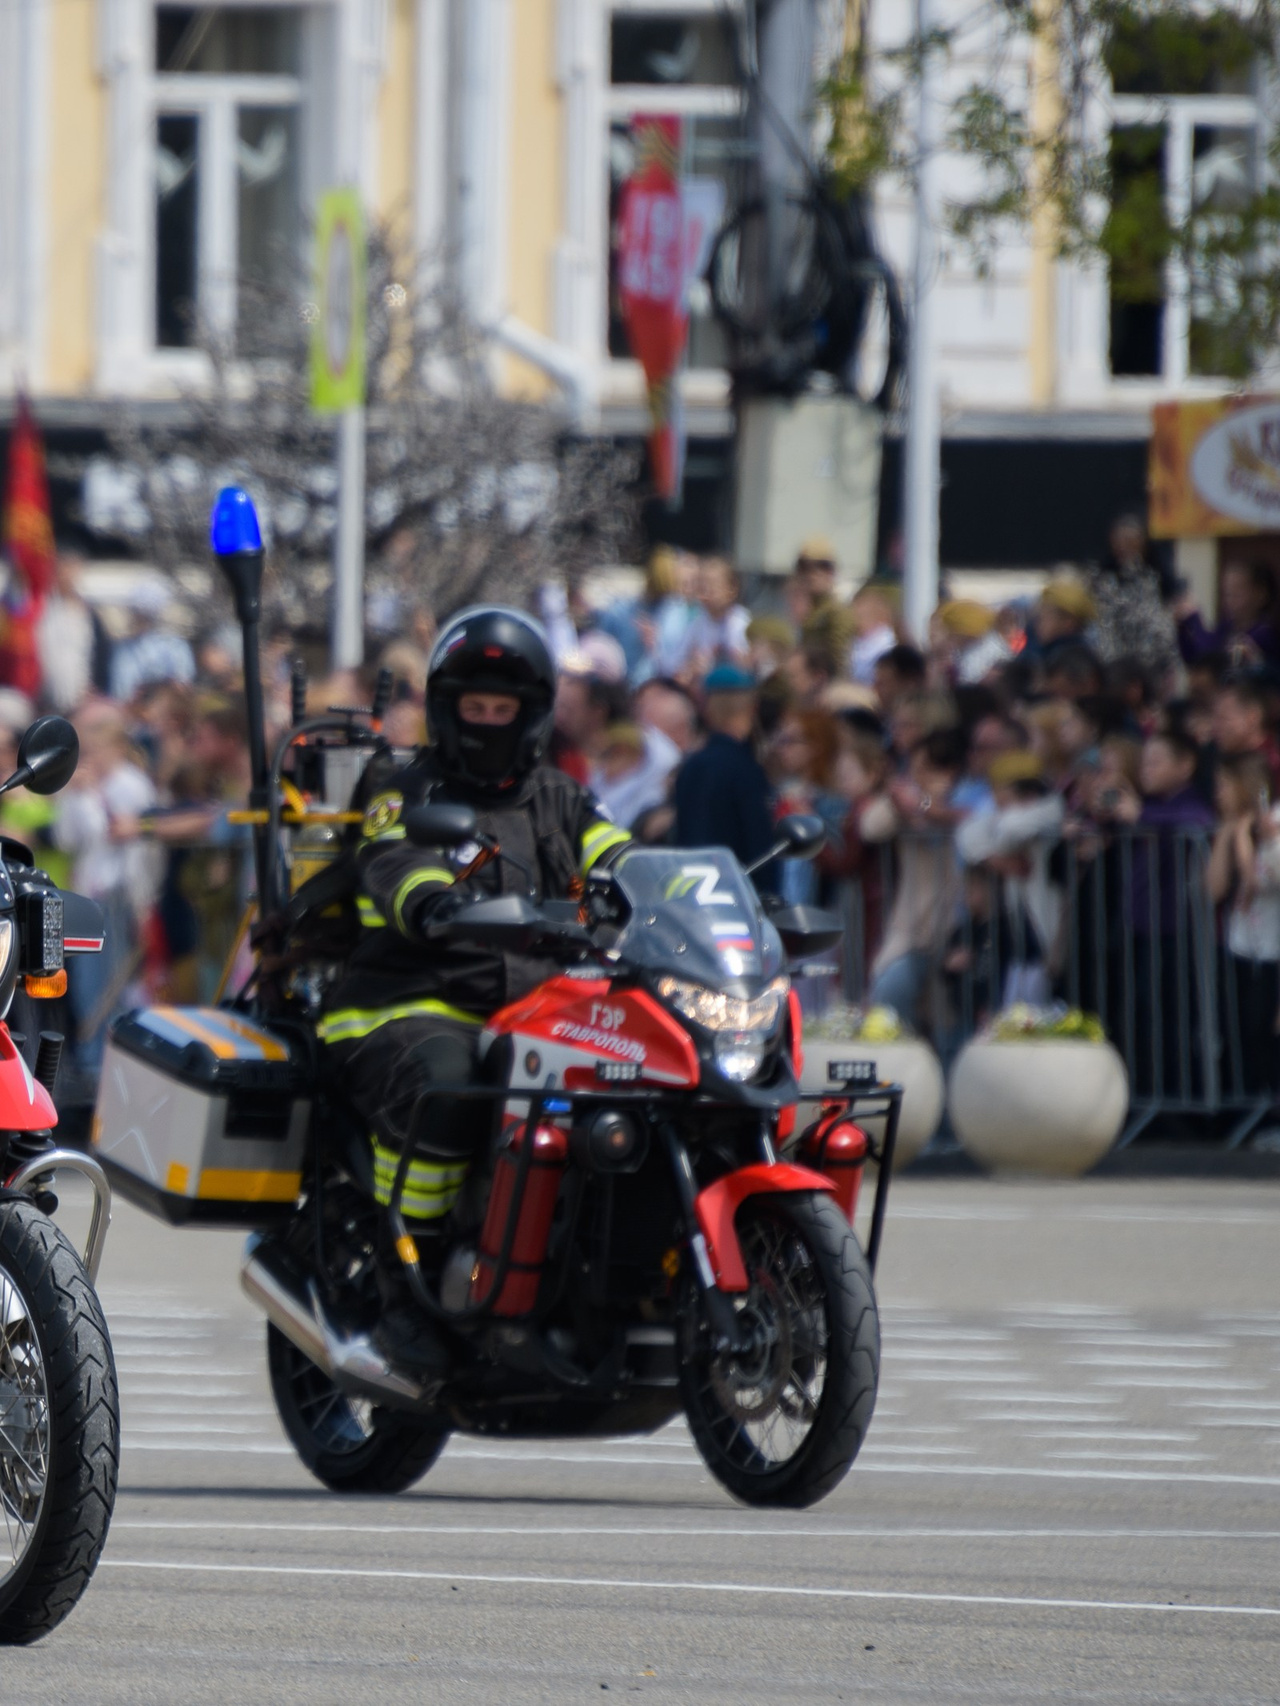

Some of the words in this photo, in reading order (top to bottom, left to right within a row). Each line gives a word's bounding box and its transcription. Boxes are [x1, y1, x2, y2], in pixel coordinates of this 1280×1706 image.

[682, 866, 735, 905] Z
[589, 1002, 626, 1031] ГЭР
[550, 1020, 648, 1063] СТАВРОПОЛЬ
